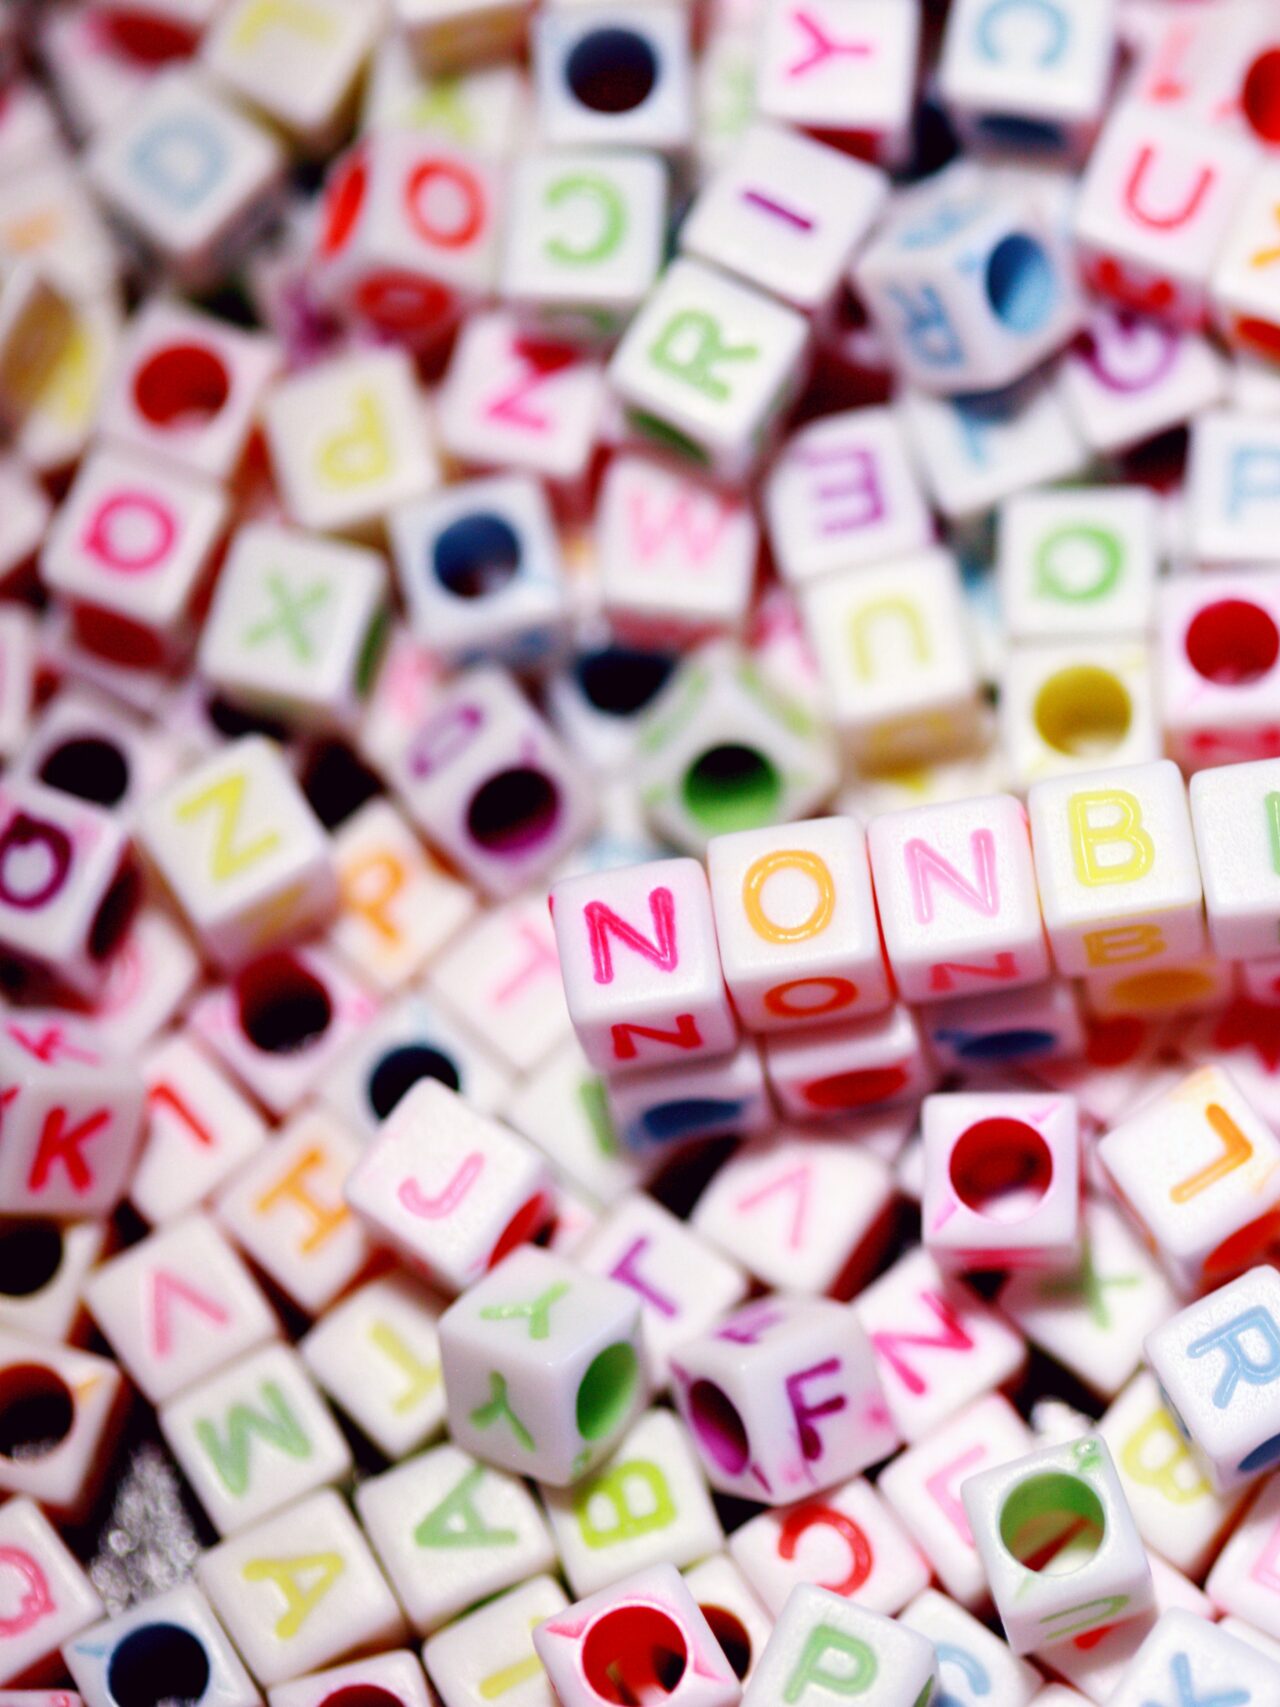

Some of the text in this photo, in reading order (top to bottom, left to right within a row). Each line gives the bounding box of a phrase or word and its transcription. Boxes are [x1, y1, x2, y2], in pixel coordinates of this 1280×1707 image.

[787, 8, 874, 80] Y
[976, 0, 1072, 70] C
[404, 156, 486, 252] O
[543, 172, 628, 268] C
[1124, 143, 1214, 232] U
[648, 308, 760, 402] R
[804, 444, 888, 540] E
[242, 568, 332, 664] X
[848, 590, 934, 686] U
[26, 1104, 114, 1196] K
[397, 1150, 486, 1222] J
[1168, 1100, 1256, 1206] L
[478, 1281, 572, 1341] Y
[468, 1368, 538, 1454] Y
[784, 1356, 848, 1462] F
[412, 1462, 520, 1550] A
[574, 1458, 680, 1550] B
[776, 1500, 874, 1599] C
[242, 1550, 346, 1642] A
[782, 1622, 880, 1706] P
